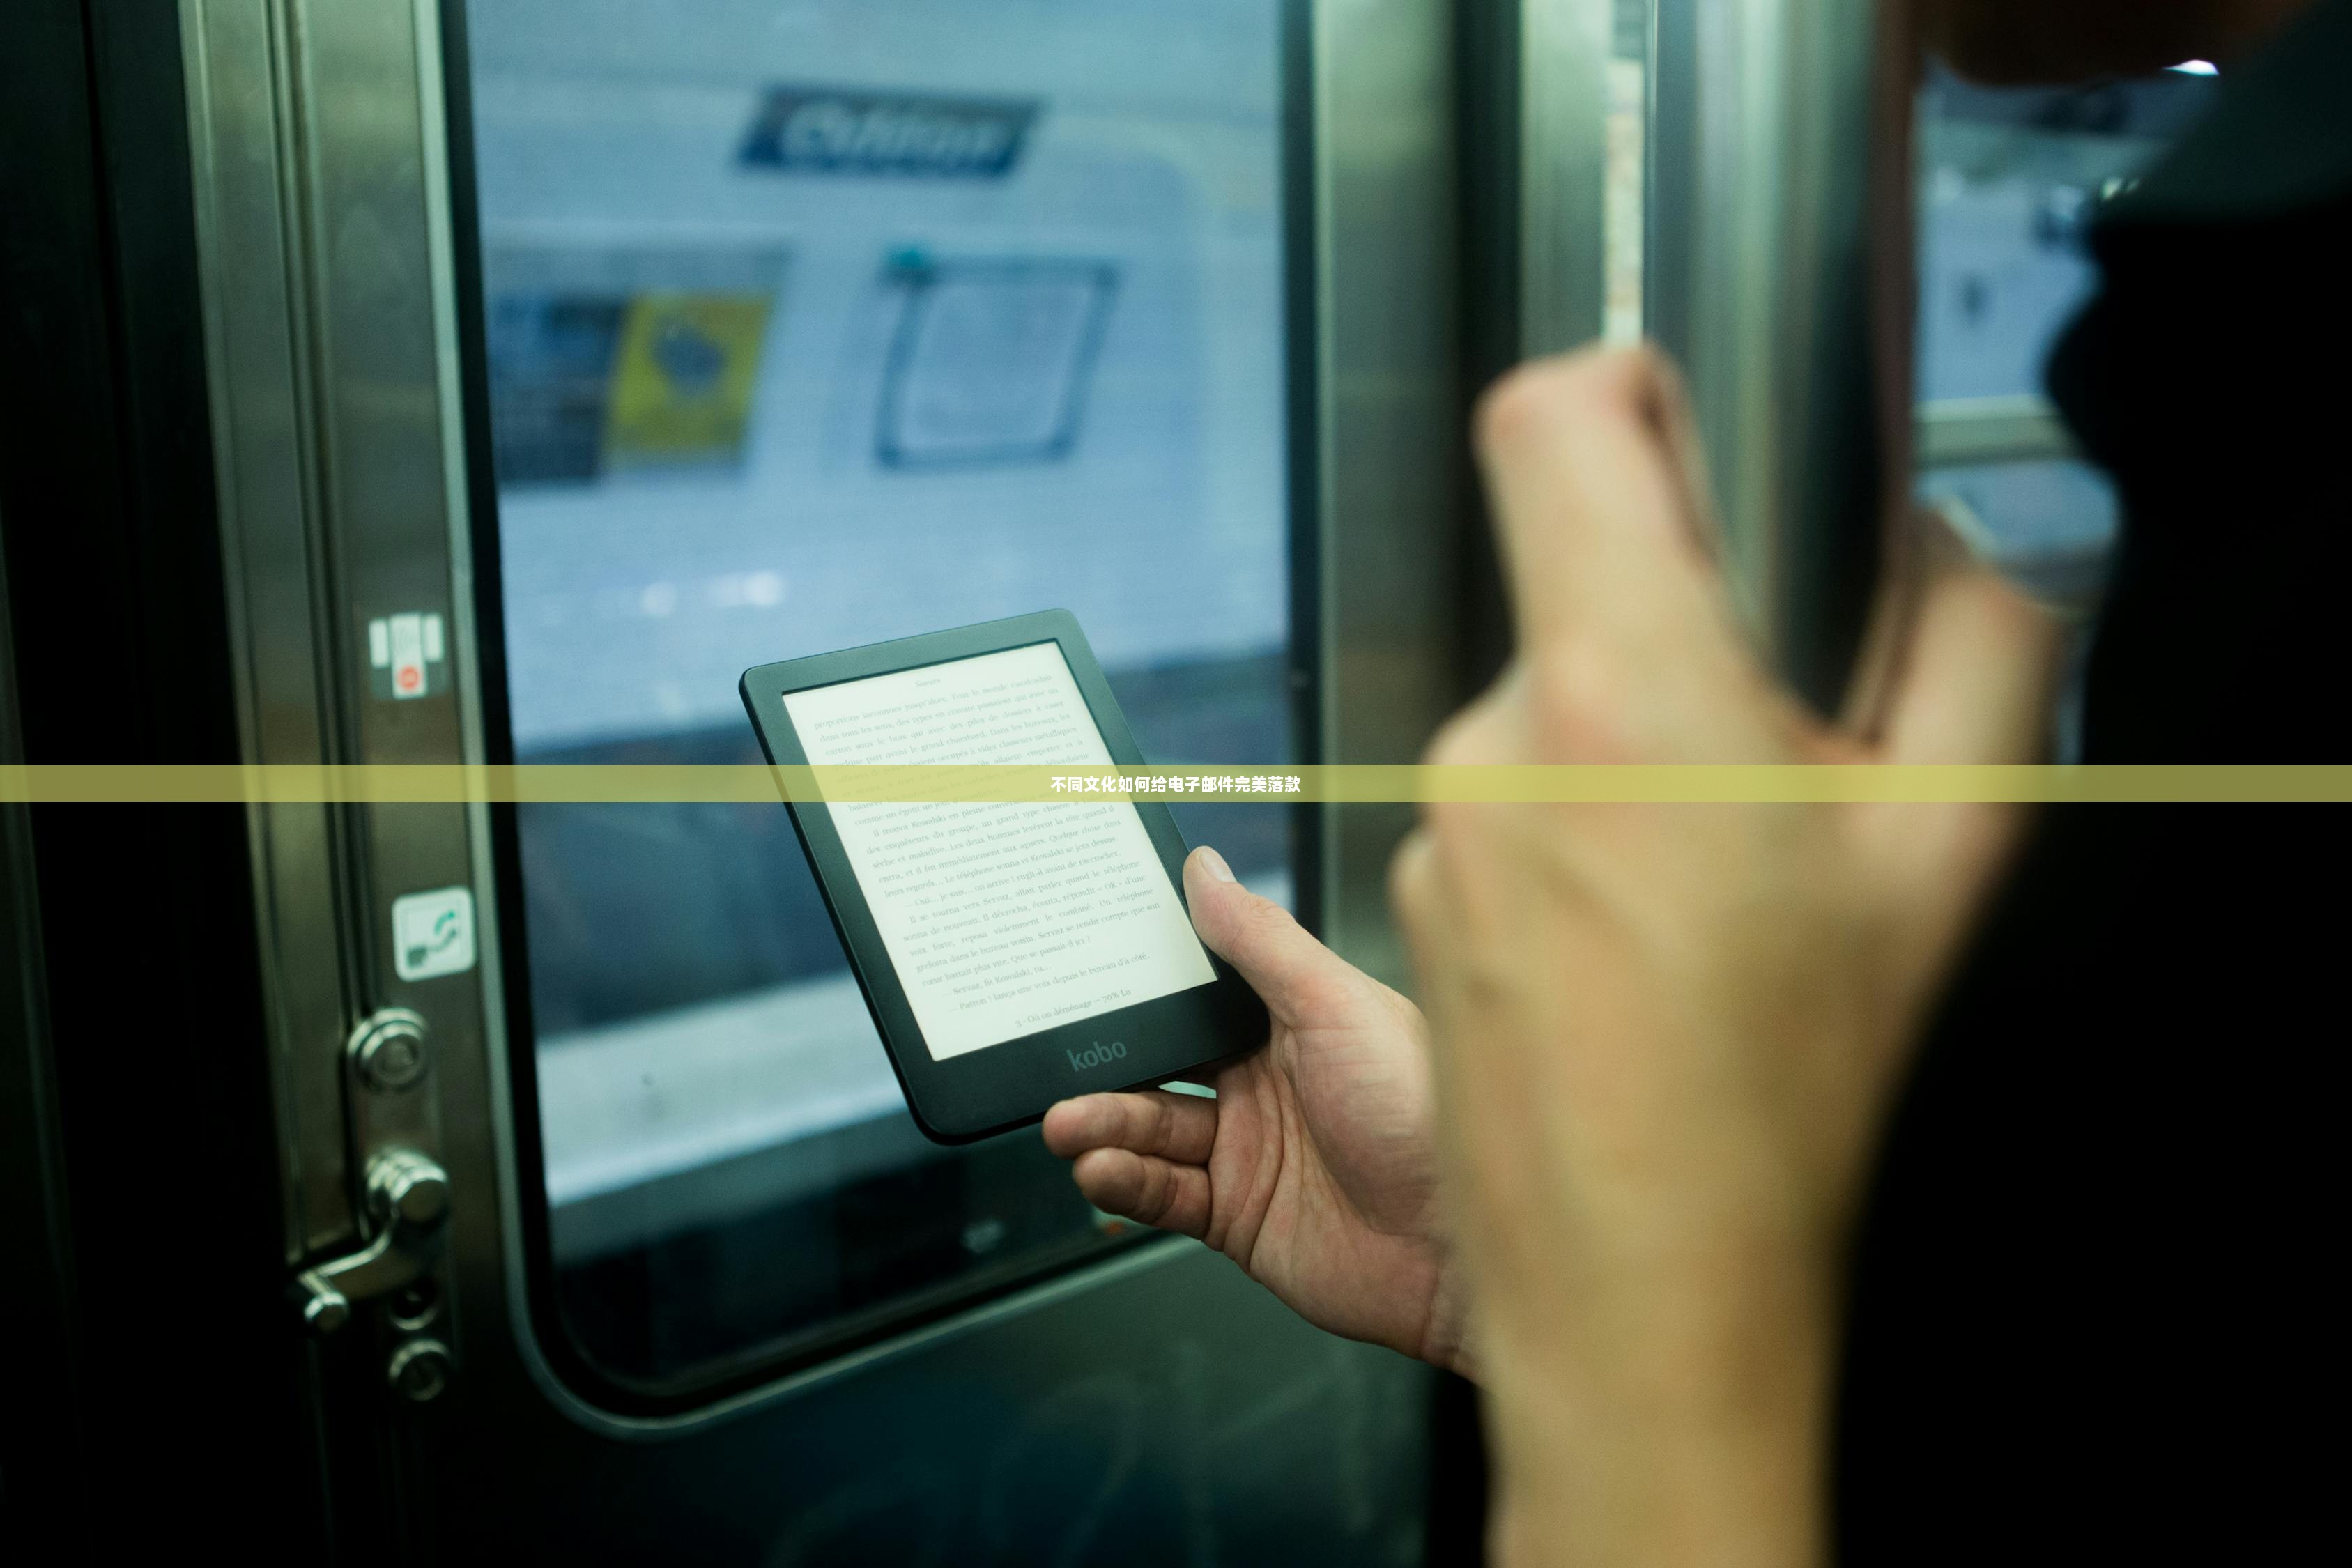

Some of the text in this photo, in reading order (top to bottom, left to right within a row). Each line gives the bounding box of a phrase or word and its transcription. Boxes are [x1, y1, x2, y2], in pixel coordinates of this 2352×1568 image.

[938, 849, 999, 868] immédiatement
[1048, 830, 1078, 842] Quelque
[1081, 824, 1100, 833] chose
[1103, 820, 1121, 828] dans
[884, 888, 904, 898] leurs
[955, 866, 994, 879] téléphone
[996, 860, 1020, 869] sonna
[1030, 848, 1064, 861] Kowalski
[1075, 843, 1090, 852] jeta
[909, 915, 916, 923] Il
[932, 907, 960, 917] tourna
[962, 901, 980, 909] vers
[1015, 886, 1035, 896] allait
[1038, 880, 1061, 893] parler
[1065, 872, 1090, 885] quand
[1103, 861, 1139, 874] téléphone
[939, 893, 947, 902] je
[986, 878, 1009, 888] arrive
[1016, 868, 1043, 881] rugit-il
[1045, 863, 1066, 873] avant
[902, 931, 928, 941] sonna
[982, 913, 989, 921] Il
[1062, 887, 1095, 900] répondit
[1103, 881, 1116, 889] OK
[1124, 875, 1144, 884] d'une
[909, 947, 927, 956] voix
[960, 932, 987, 943] reposa
[993, 918, 1039, 934] violemment
[1116, 889, 1153, 902] téléphone
[915, 958, 948, 973] grelotta
[949, 953, 969, 962] dans
[979, 942, 1008, 954] bureau
[1037, 928, 1063, 939] Servaz
[1075, 918, 1099, 929] rendit
[1100, 911, 1128, 921] compte
[1130, 907, 1144, 916] que
[921, 976, 942, 986] cœur
[944, 968, 971, 980] battait
[973, 964, 991, 974] plus
[1010, 953, 1027, 962] Que
[1039, 939, 1074, 957] passait-il
[958, 998, 987, 1010] Patron
[992, 990, 1015, 1000] lança
[1017, 985, 1031, 994] une
[1033, 981, 1051, 989] voix
[1052, 973, 1079, 984] depuis
[1087, 962, 1116, 974] bureau
[1052, 1000, 1091, 1015] déménage
[1102, 992, 1119, 1002] 70%
[1066, 1041, 1127, 1072] kobo
